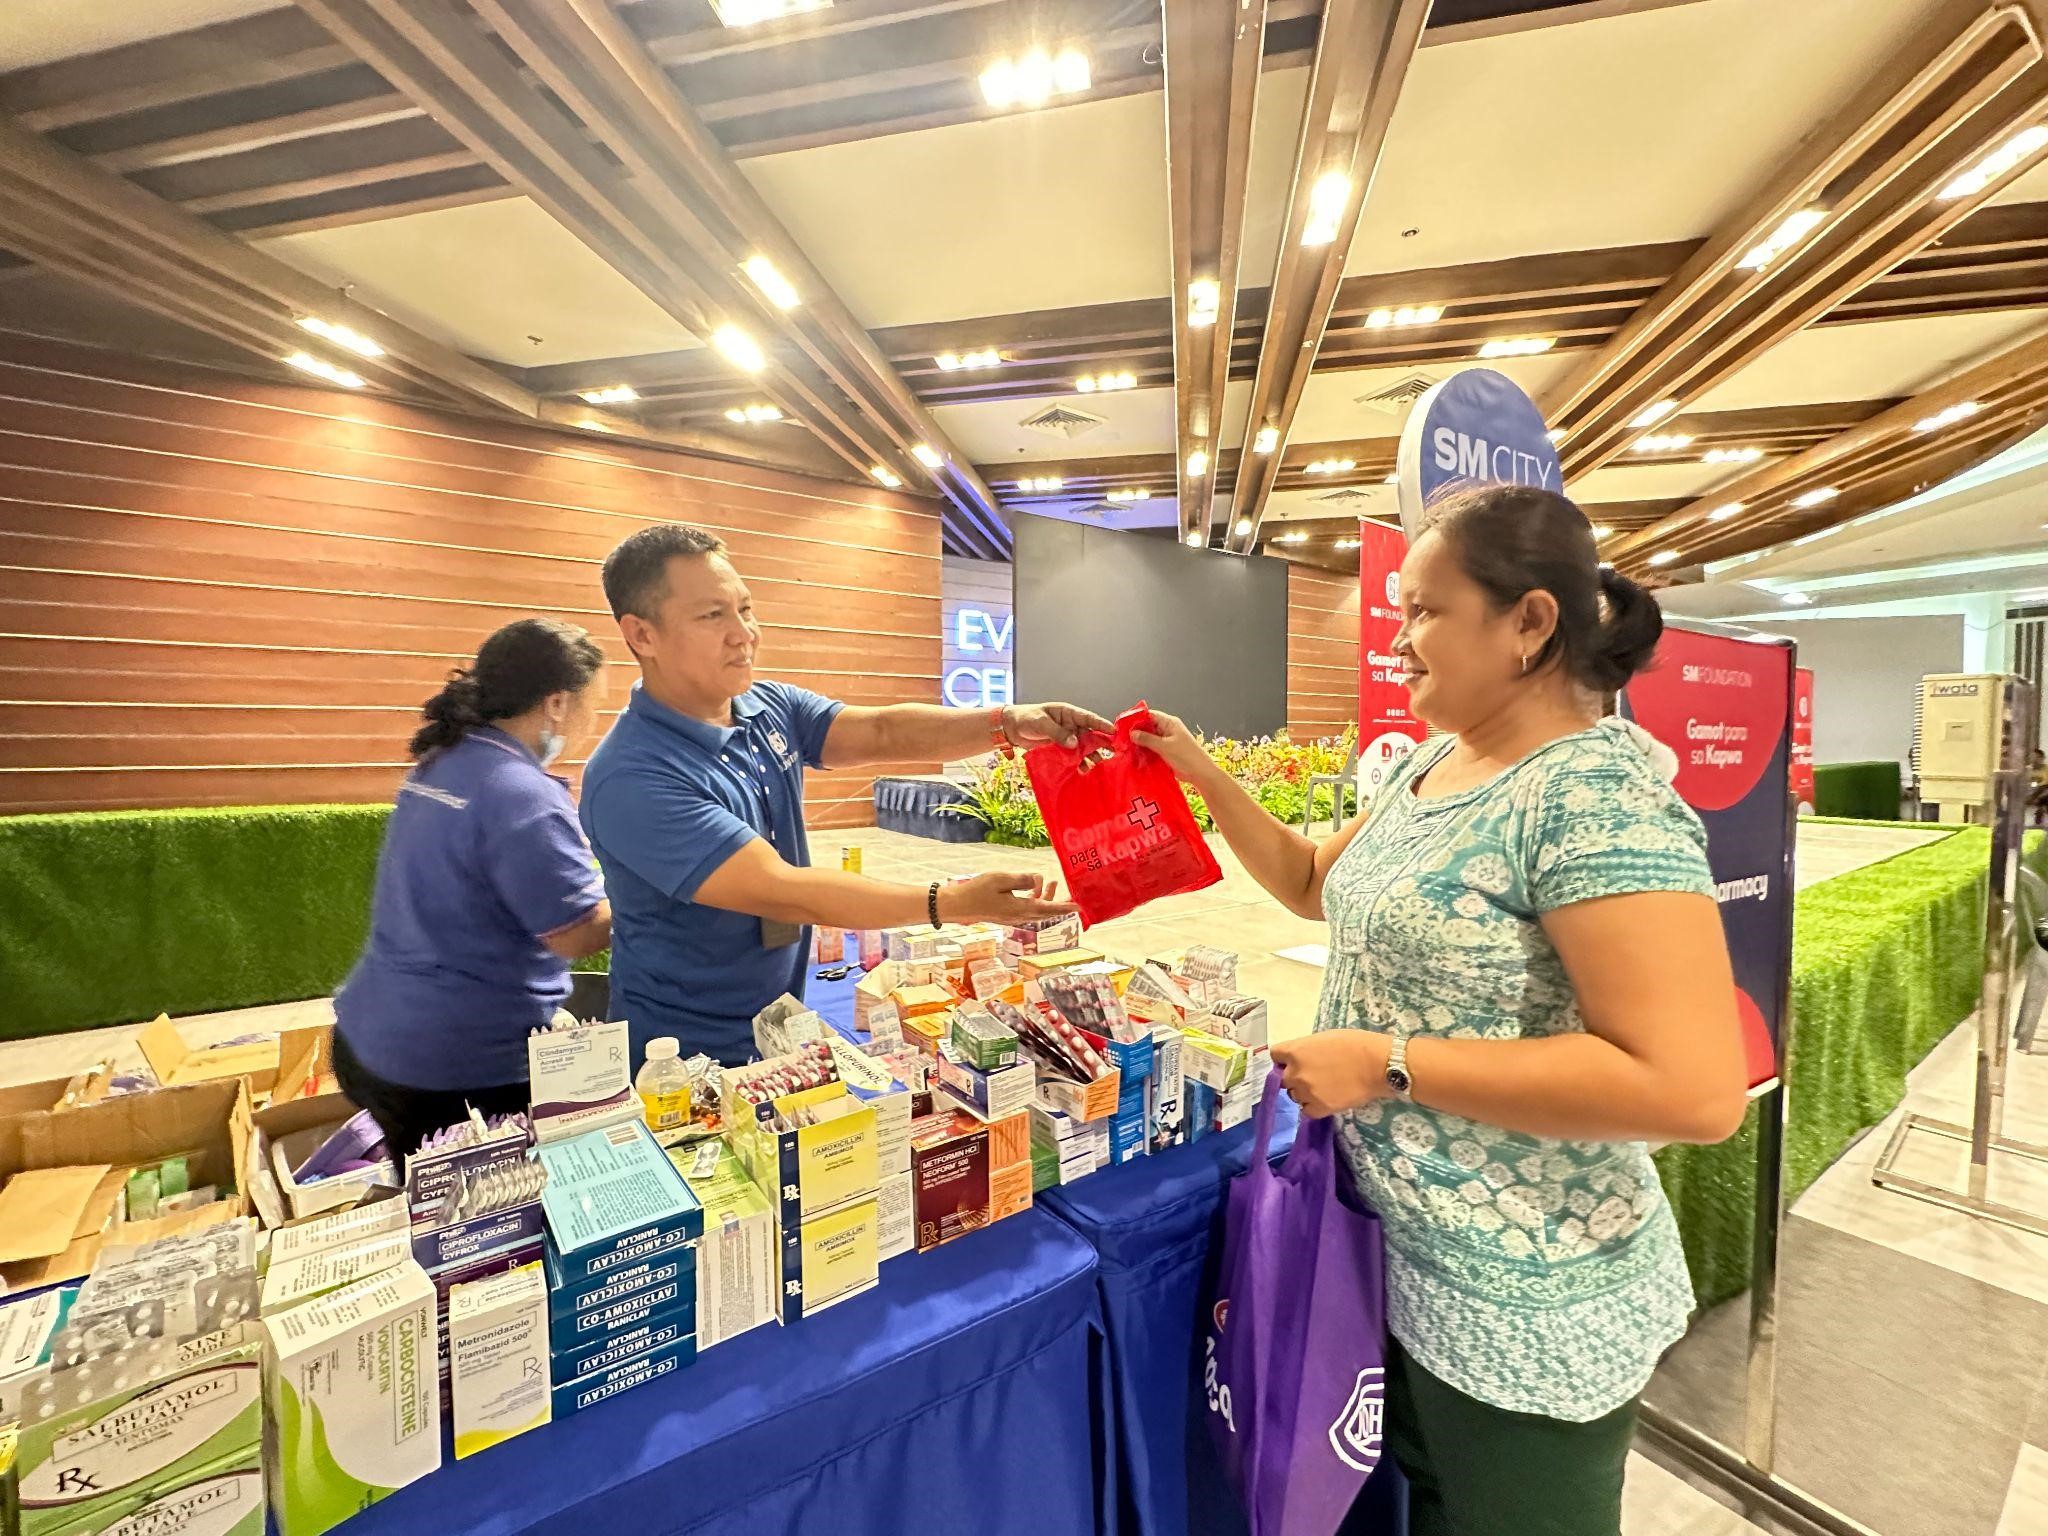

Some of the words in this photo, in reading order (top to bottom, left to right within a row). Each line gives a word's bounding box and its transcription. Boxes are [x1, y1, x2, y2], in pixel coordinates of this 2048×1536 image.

[1434, 427, 1488, 481] SM
[1492, 445, 1553, 490] CITY
[1367, 649, 1401, 668] Gamot
[944, 666, 1014, 708] CE
[1372, 670, 1384, 682] sa
[1385, 667, 1408, 686] Kap
[1931, 682, 1978, 694] iwata
[1686, 717, 1724, 740] Gamot
[1725, 726, 1748, 744] para
[1691, 749, 1705, 764] sa
[1705, 744, 1743, 769] Kapwa
[1069, 844, 1099, 867] para
[1101, 821, 1173, 866] Kapwa
[1087, 857, 1103, 873] sa
[1716, 874, 1769, 903] armacy
[540, 1044, 585, 1058] Clindamycin
[815, 1135, 862, 1156] AMOXICILLIN
[922, 1149, 965, 1170] METFORMIN
[441, 1221, 519, 1252] CIPROFLOXACIN
[592, 1231, 682, 1271] CO-AMOXICLAV
[616, 1227, 659, 1249] RANICLAV
[817, 1226, 864, 1249] AMOXICILLIN
[442, 1243, 480, 1261] CYFROX
[582, 1266, 673, 1307] CO-AMOXICLAV
[606, 1263, 650, 1285] RANICLAV
[582, 1287, 673, 1328] CO-AMOXICLAV
[606, 1307, 651, 1331] RANICLAV
[456, 1319, 530, 1350] Metronidazole
[458, 1337, 510, 1362] Flamibazid
[511, 1331, 529, 1344] 500
[606, 1325, 650, 1350] RANICLAV
[377, 1324, 391, 1395] VONCARTIN
[582, 1328, 673, 1371] CO-AMOXICLAV
[399, 1317, 417, 1438] CARBOCISTEINE
[582, 1360, 673, 1405] CO-AMOXICLAV
[606, 1358, 650, 1383] RANICLAV
[68, 1379, 225, 1447] SALBUTAMOL
[103, 1400, 193, 1440] SULFATE
[56, 1466, 102, 1495] Rx
[117, 1485, 228, 1536] BUTAMOL
